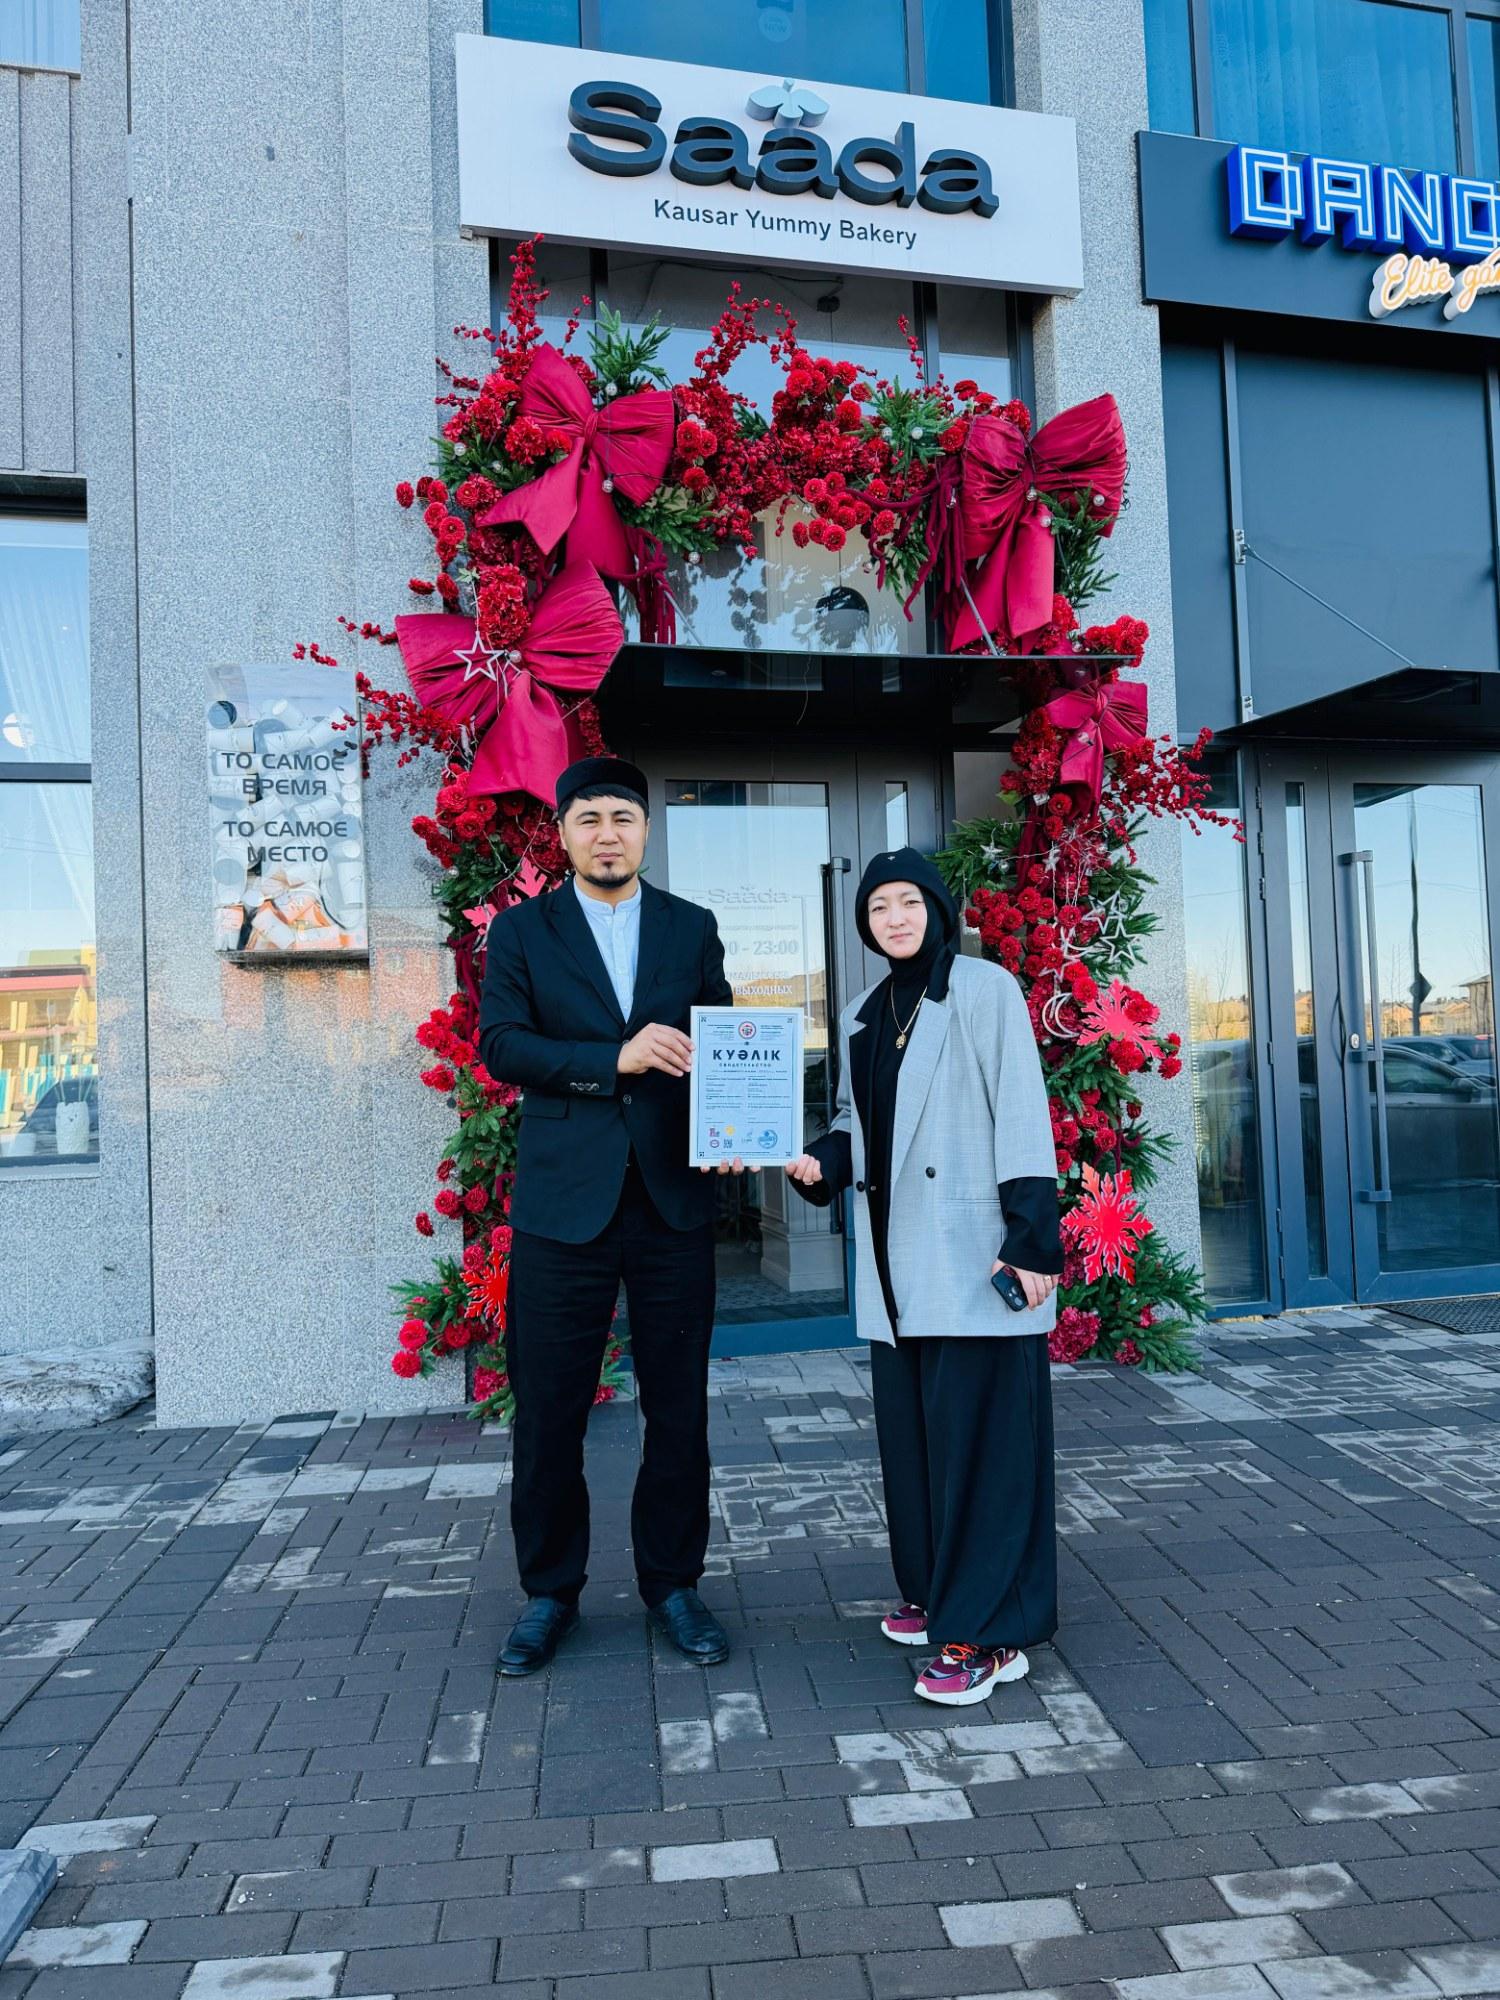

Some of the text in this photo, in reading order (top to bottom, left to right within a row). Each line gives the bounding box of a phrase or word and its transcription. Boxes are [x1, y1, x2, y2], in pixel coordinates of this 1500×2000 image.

[653, 198, 917, 250] Kausar Yummy Bakery
[1370, 252, 1455, 319] Elite
[221, 752, 345, 772] ТО САМОЕ
[242, 778, 328, 796] ВРЕМЯ
[223, 820, 348, 838] ТО САМОЕ
[247, 846, 329, 862] МЕСТО
[753, 939, 799, 956] 23:00
[712, 1049, 781, 1062] КУӘЛІК
